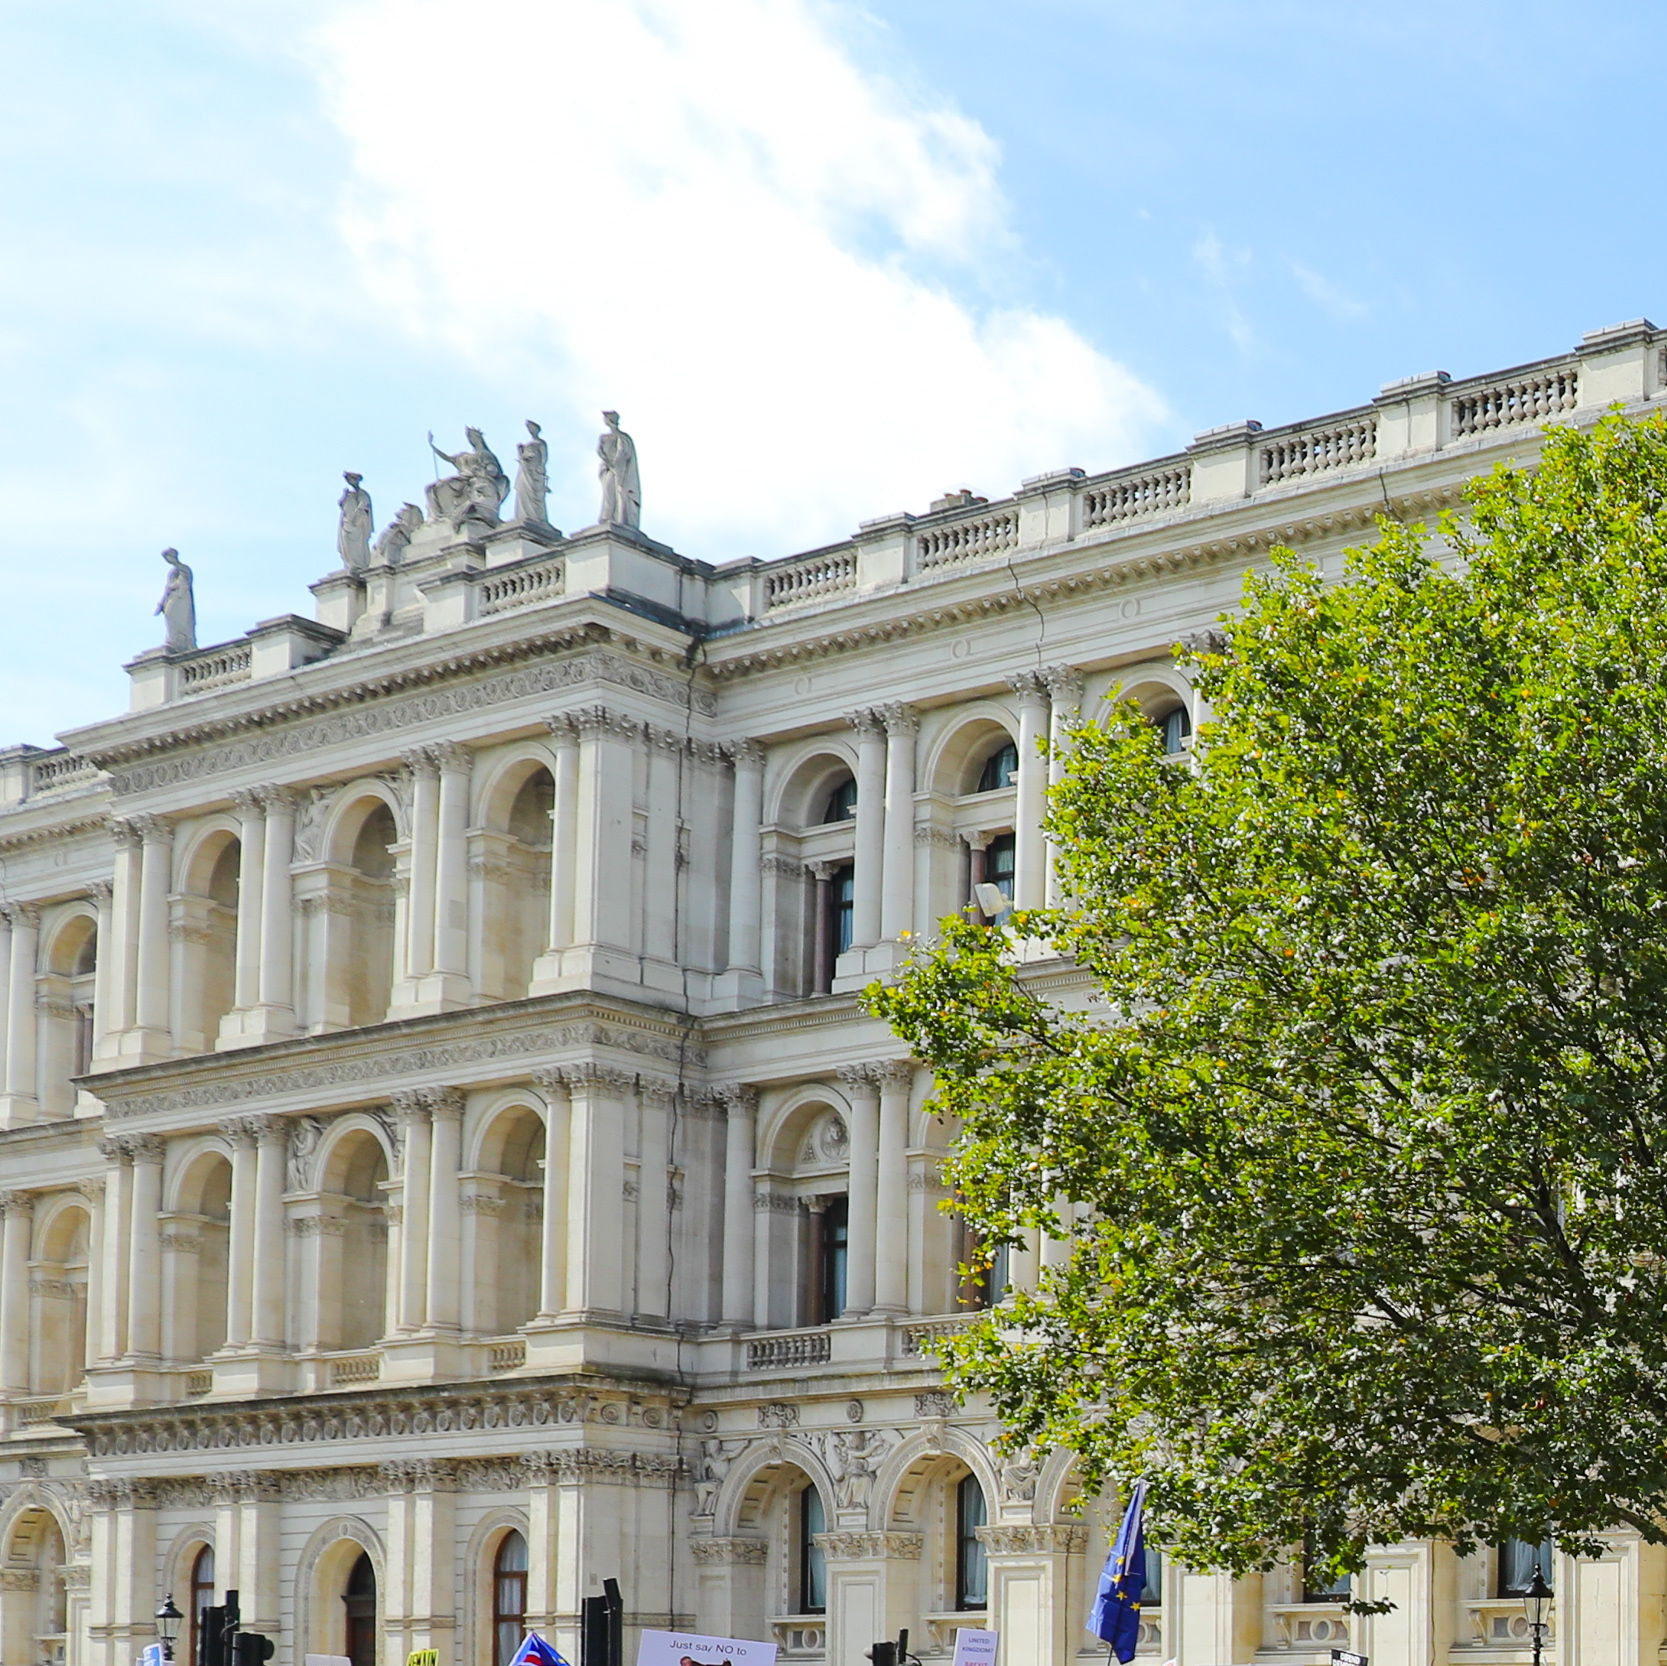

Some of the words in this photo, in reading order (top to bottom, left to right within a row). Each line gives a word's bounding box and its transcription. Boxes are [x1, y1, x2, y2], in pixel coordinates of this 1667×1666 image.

[669, 1640, 692, 1651] Just
[715, 1644, 734, 1654] NO
[736, 1646, 747, 1655] to
